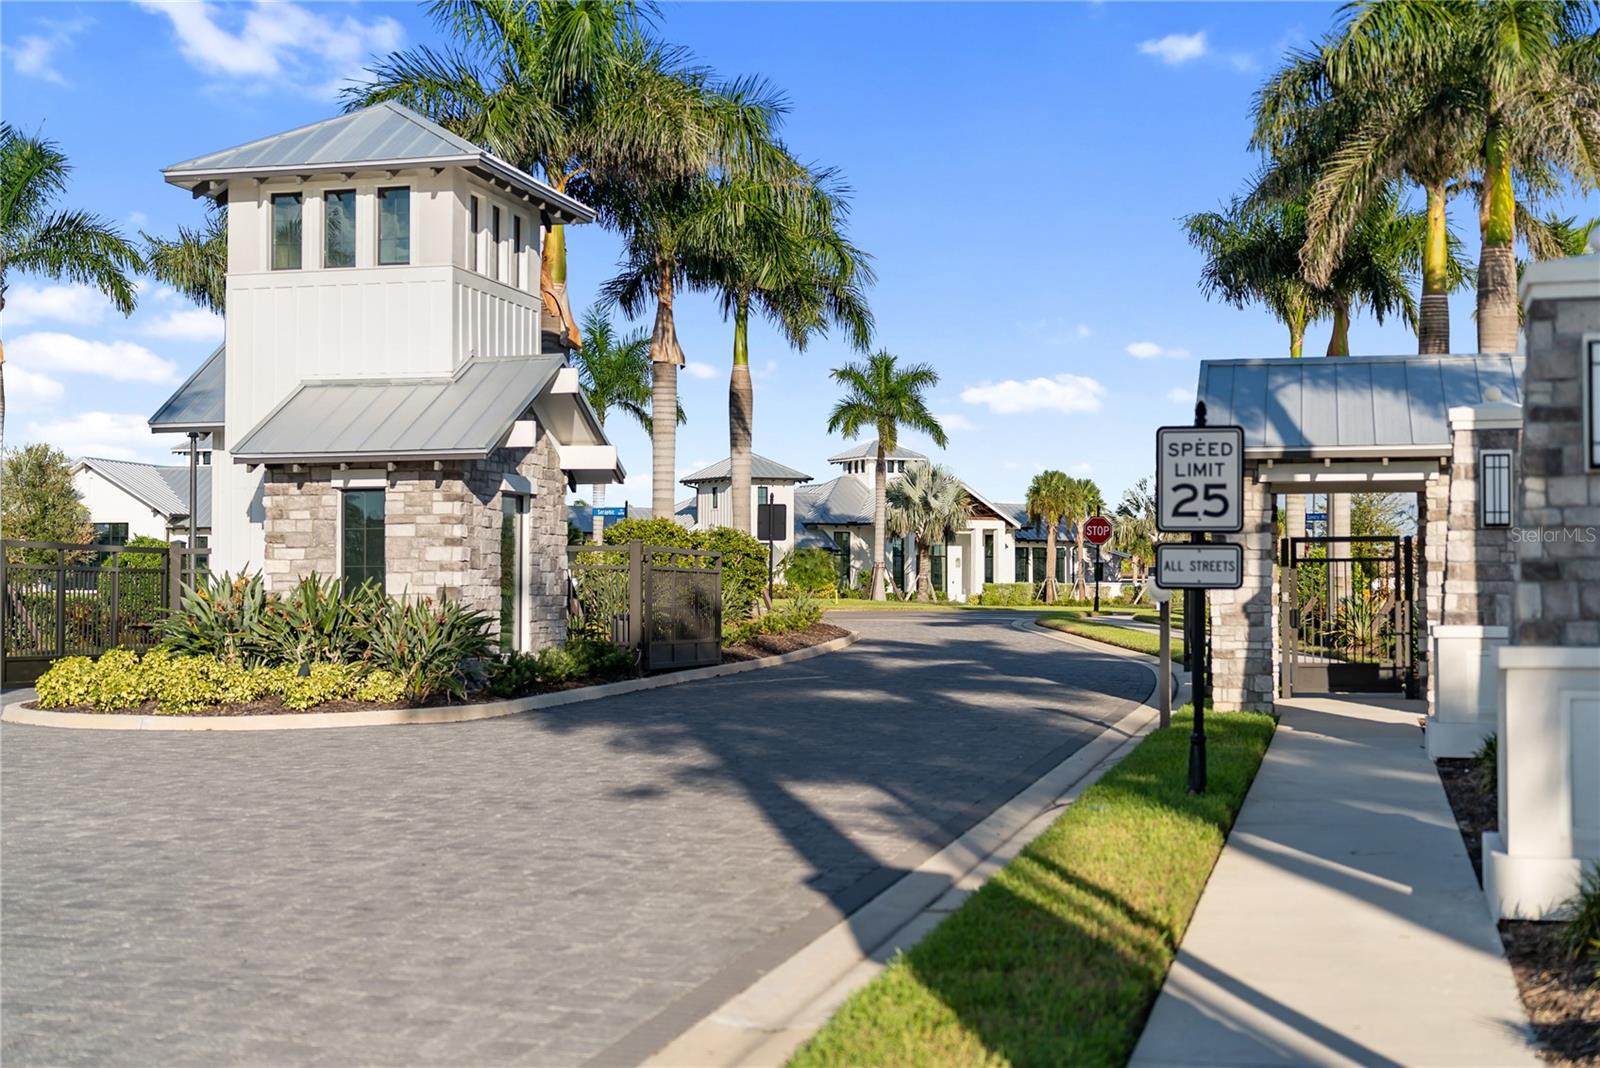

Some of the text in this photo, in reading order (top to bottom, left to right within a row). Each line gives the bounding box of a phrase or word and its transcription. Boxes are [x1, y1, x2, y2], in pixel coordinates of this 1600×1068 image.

[1168, 442, 1233, 457] SPEED
[1175, 462, 1225, 477] LIMIT
[1171, 483, 1229, 518] 25
[1086, 525, 1110, 536] STOP
[1164, 560, 1235, 573] ALL STREETS
